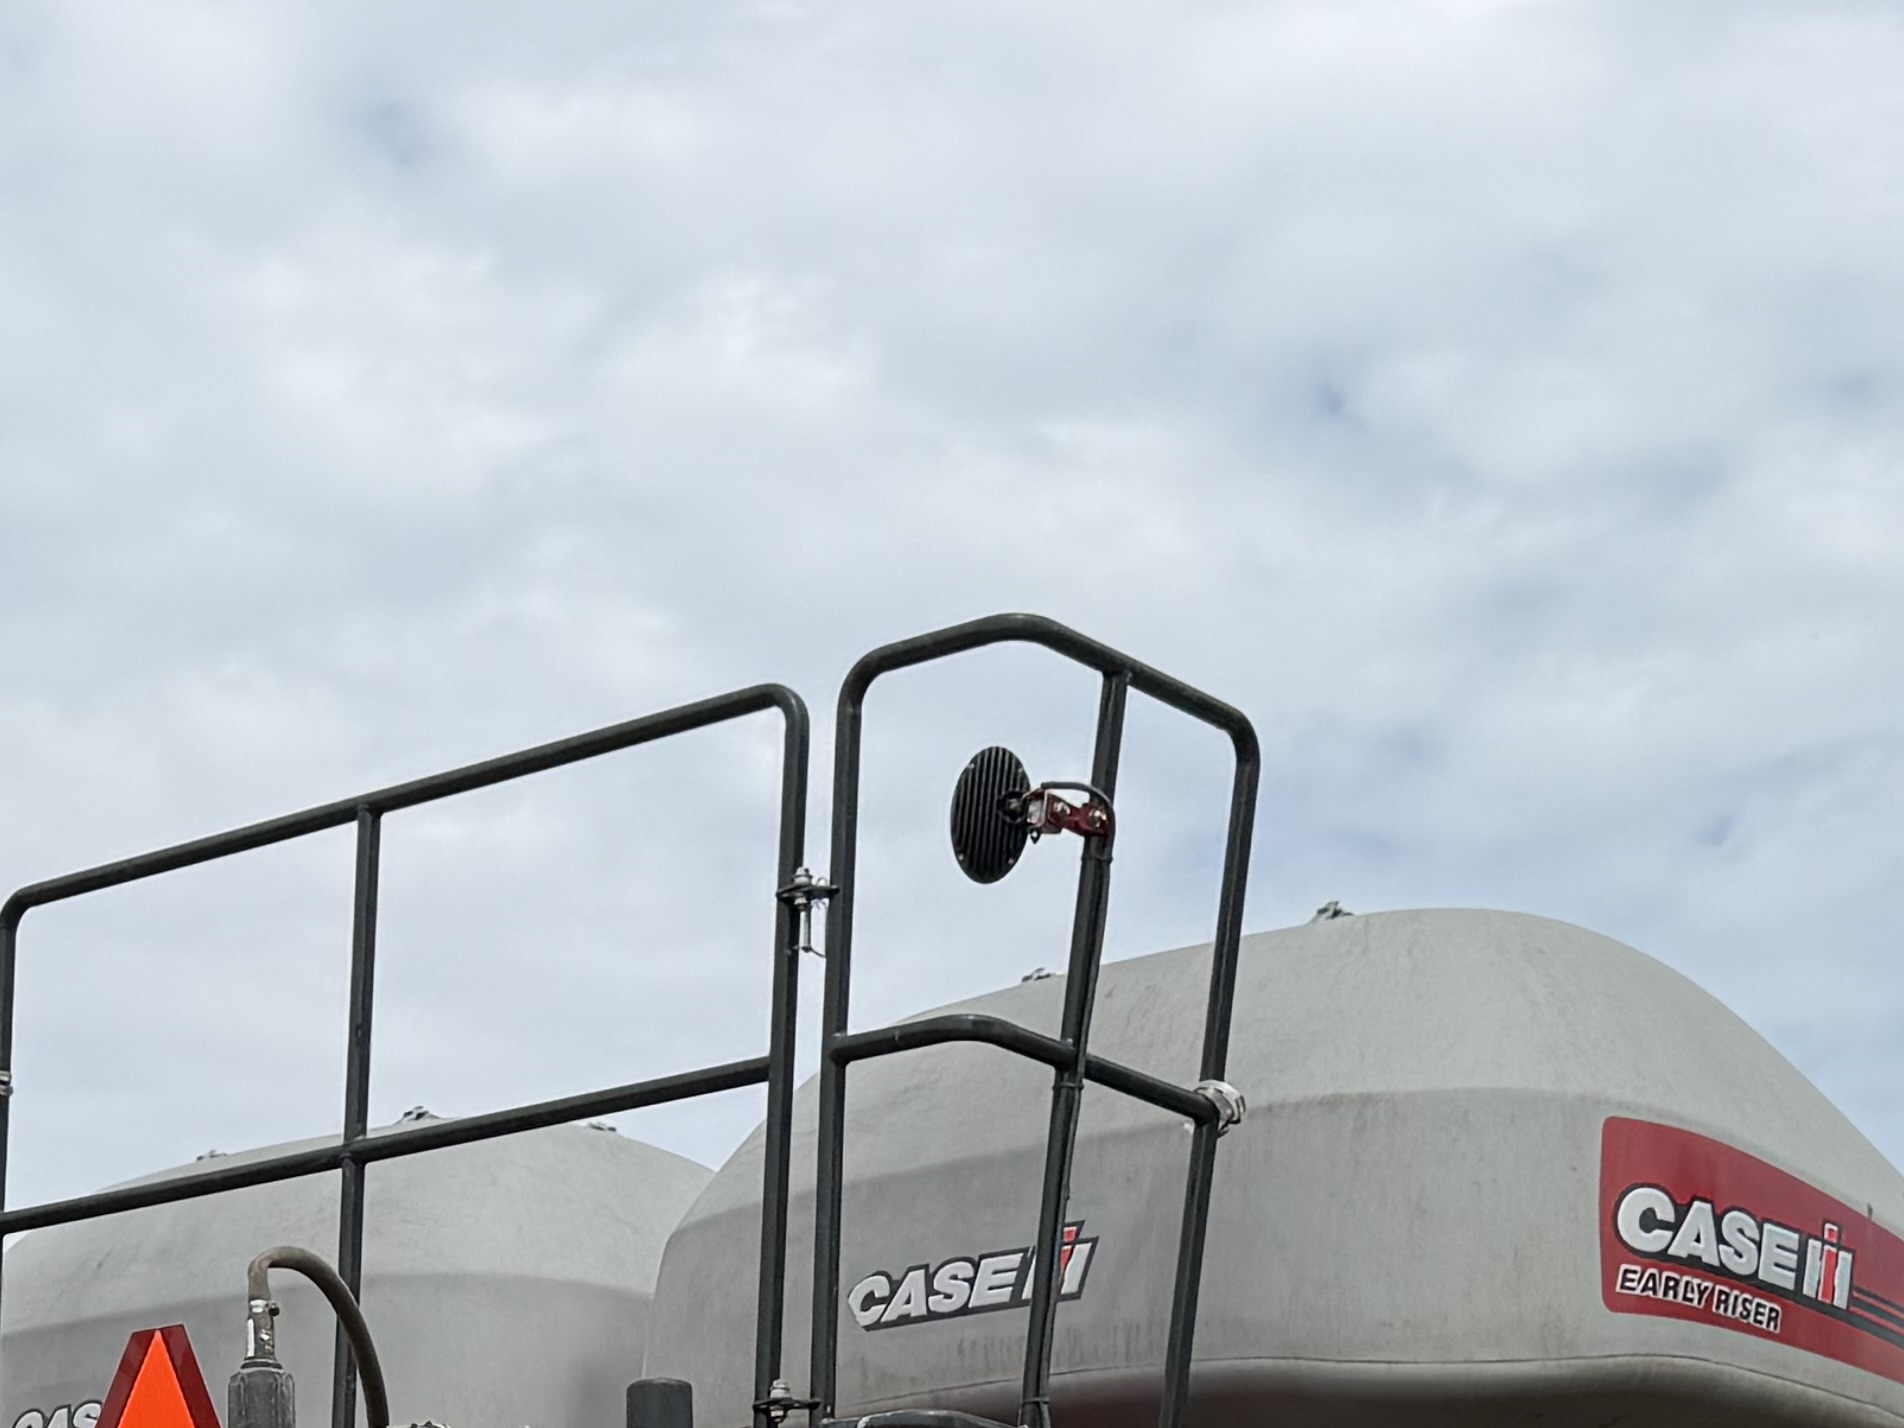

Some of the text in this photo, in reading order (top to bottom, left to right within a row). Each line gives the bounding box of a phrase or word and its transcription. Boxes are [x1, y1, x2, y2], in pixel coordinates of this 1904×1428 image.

[1616, 1186, 1800, 1291] CASE
[848, 1252, 1025, 1327] CASE
[1616, 1264, 1782, 1333] EARLY RISER
